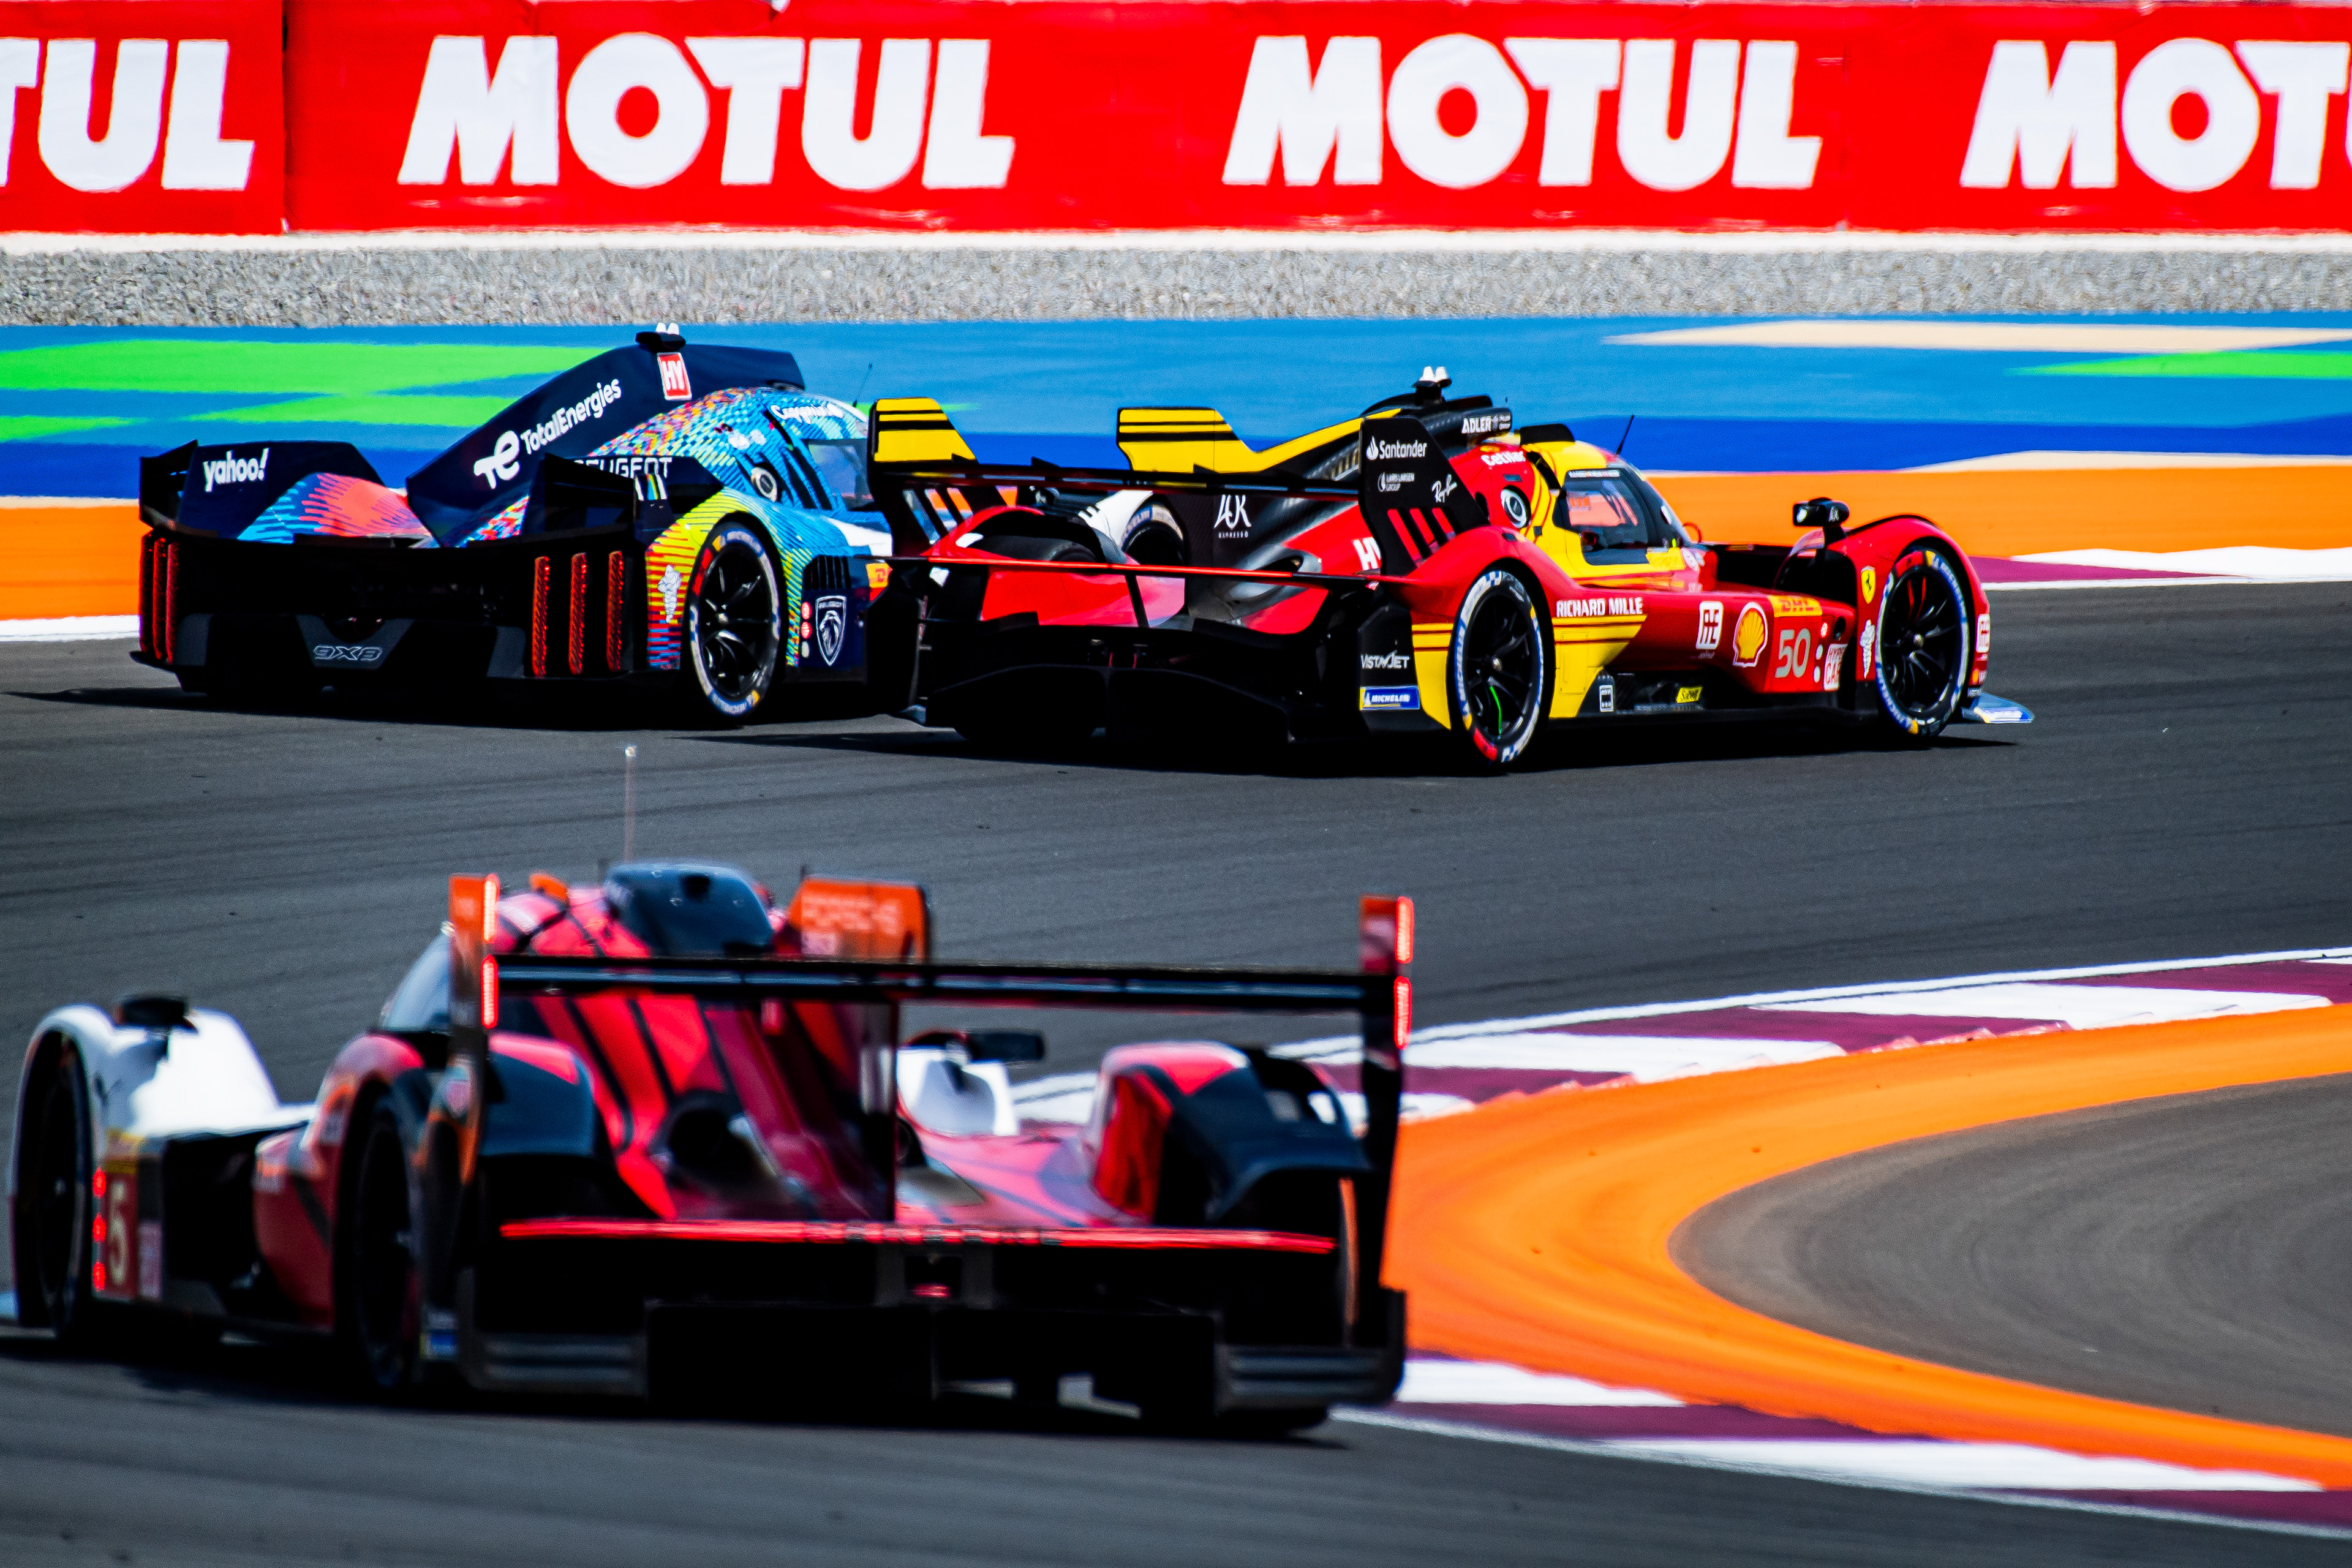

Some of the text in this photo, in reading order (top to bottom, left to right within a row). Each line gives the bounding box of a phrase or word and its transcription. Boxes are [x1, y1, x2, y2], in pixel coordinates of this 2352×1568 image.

[398, 33, 1015, 190] MOTUL
[1222, 34, 1822, 191] MOTUL
[1960, 38, 2352, 192] MOT
[662, 360, 685, 391] HY
[521, 379, 622, 454] TotalEnergies
[1461, 415, 1491, 434] ADLER
[1379, 440, 1427, 459] Santander
[1480, 450, 1526, 466] Cetilar
[203, 447, 270, 492] yahoo!
[573, 456, 673, 480] UGEOT
[1556, 597, 1643, 618] RICHARD MILLE
[1779, 598, 1814, 612] DHL
[313, 646, 383, 661] 9X8
[1775, 628, 1811, 679] 50
[1371, 693, 1411, 703] MICHELIN
[108, 1181, 129, 1286] 5
